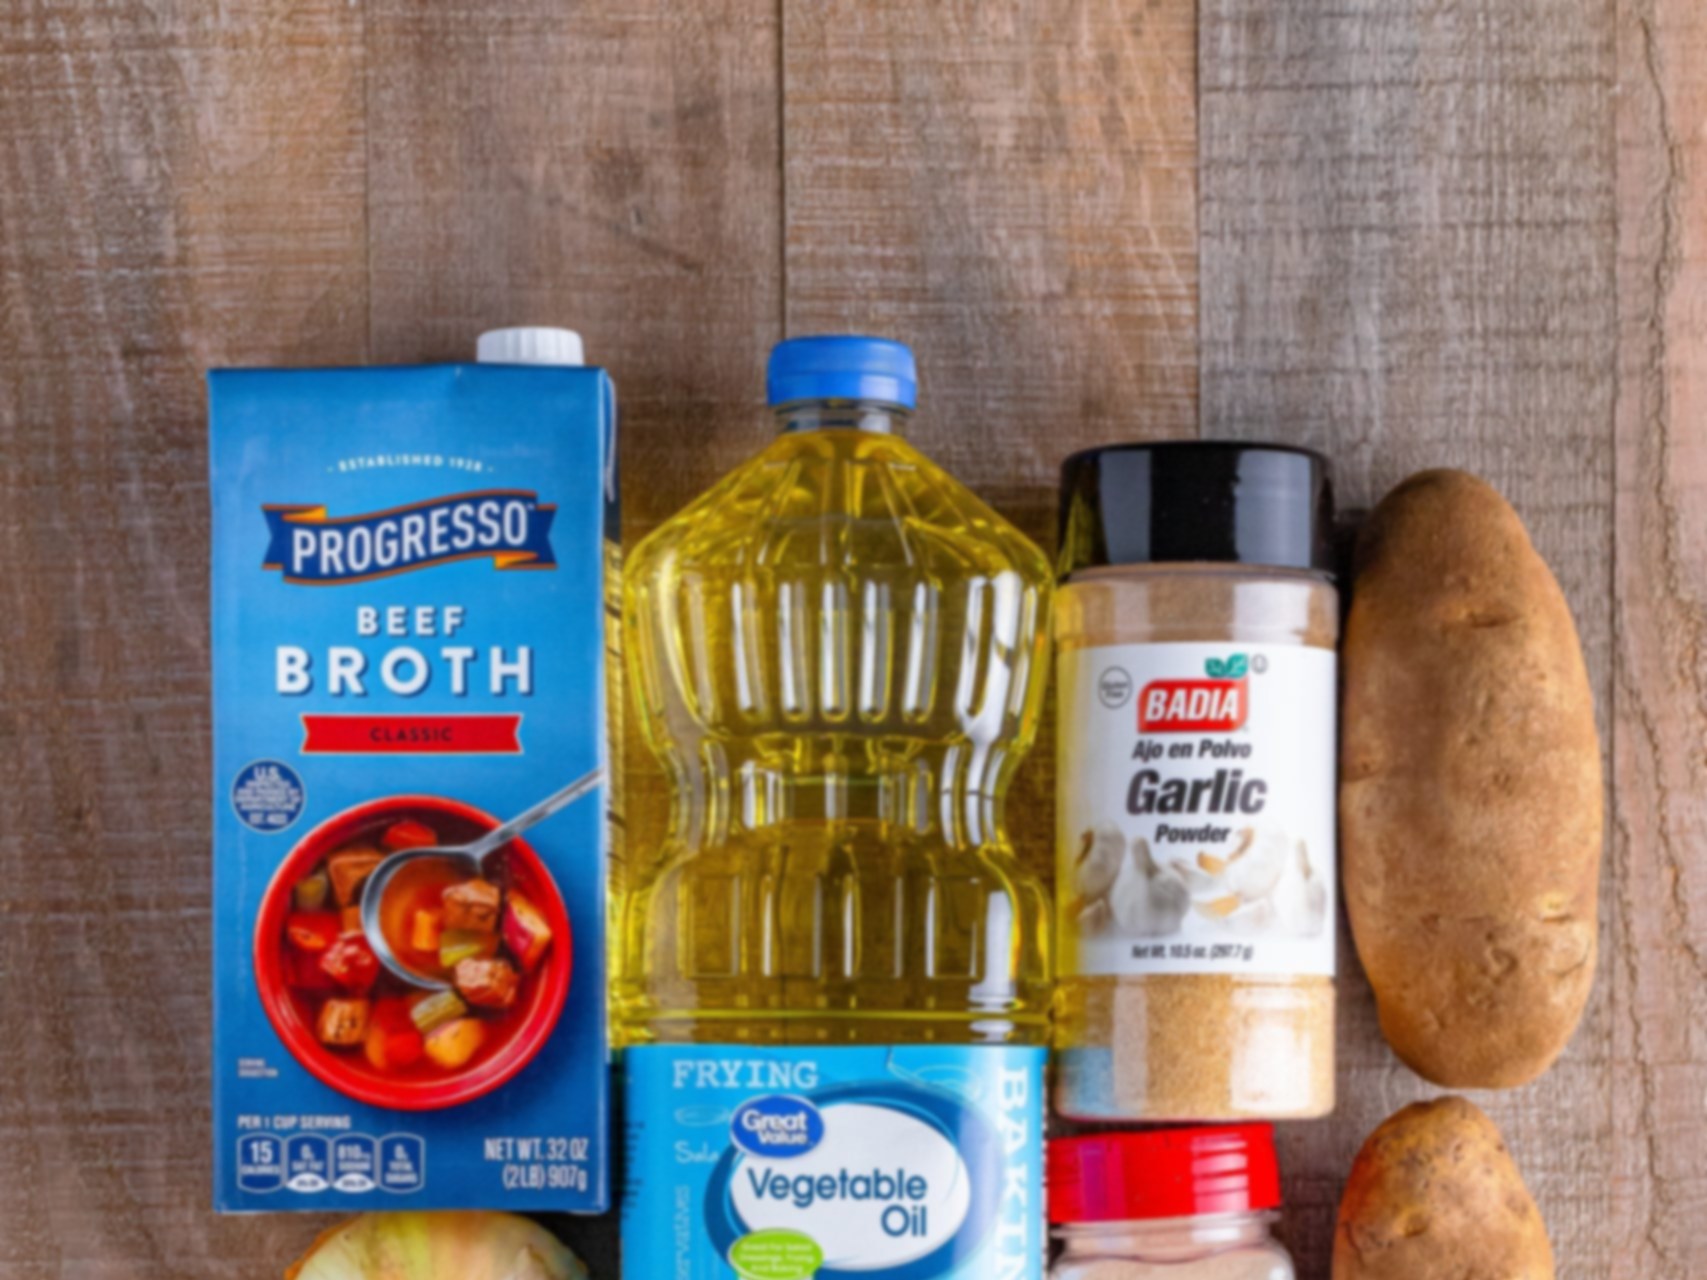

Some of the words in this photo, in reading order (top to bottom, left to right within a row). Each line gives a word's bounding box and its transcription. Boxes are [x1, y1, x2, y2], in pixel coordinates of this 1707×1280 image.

[338, 454, 444, 473] ESTABLISHED
[448, 456, 483, 473] 1928
[291, 500, 529, 575] PROGRESSO
[356, 605, 465, 636] BEEF
[275, 645, 533, 696] BROTH
[1144, 688, 1239, 721] BADIA
[369, 726, 454, 743] CLASSIC
[1131, 740, 1164, 763] Ajo
[1167, 744, 1194, 759] en
[1197, 739, 1253, 760] Polvo
[1125, 768, 1268, 817] Garlic
[1154, 824, 1231, 844] Powder
[672, 1059, 819, 1089] FRYING
[741, 1109, 808, 1133] Great
[484, 1137, 514, 1161] NET
[547, 1137, 567, 1161] 32
[569, 1137, 588, 1161] OZ
[756, 1129, 808, 1146] Value
[249, 1140, 273, 1163] 15
[674, 1140, 720, 1165] Sala
[746, 1167, 928, 1209] Vegetable
[880, 1204, 928, 1238] Oil
